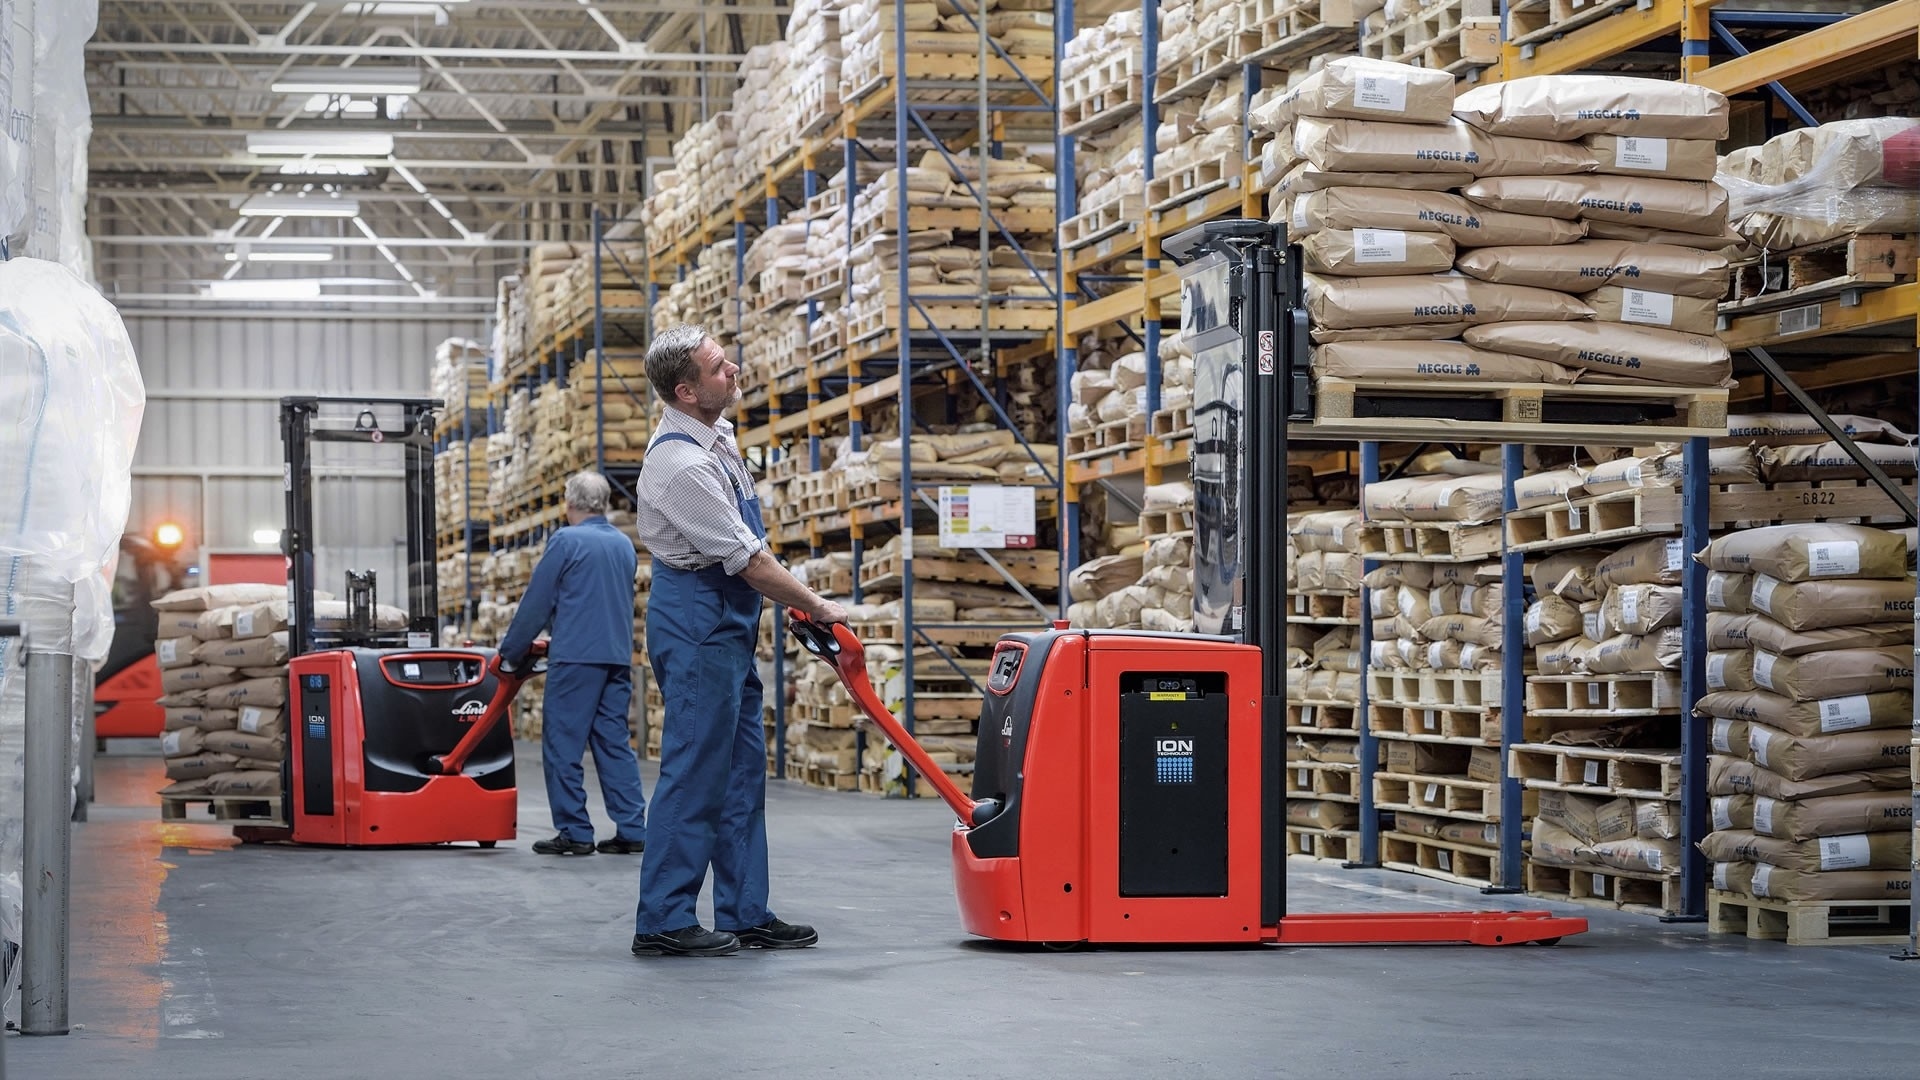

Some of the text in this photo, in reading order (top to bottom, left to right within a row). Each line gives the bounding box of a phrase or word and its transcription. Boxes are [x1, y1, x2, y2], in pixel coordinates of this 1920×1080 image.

[1416, 150, 1461, 162] MEGGLE
[1581, 198, 1625, 212] MEGGLE
[1418, 209, 1462, 226] MEGGLE
[1414, 305, 1459, 317] MEGGLE
[1578, 350, 1623, 366] MEGGLE
[1417, 363, 1462, 375] MEGGLE
[308, 715, 325, 723] ION
[1156, 740, 1193, 752] ION
